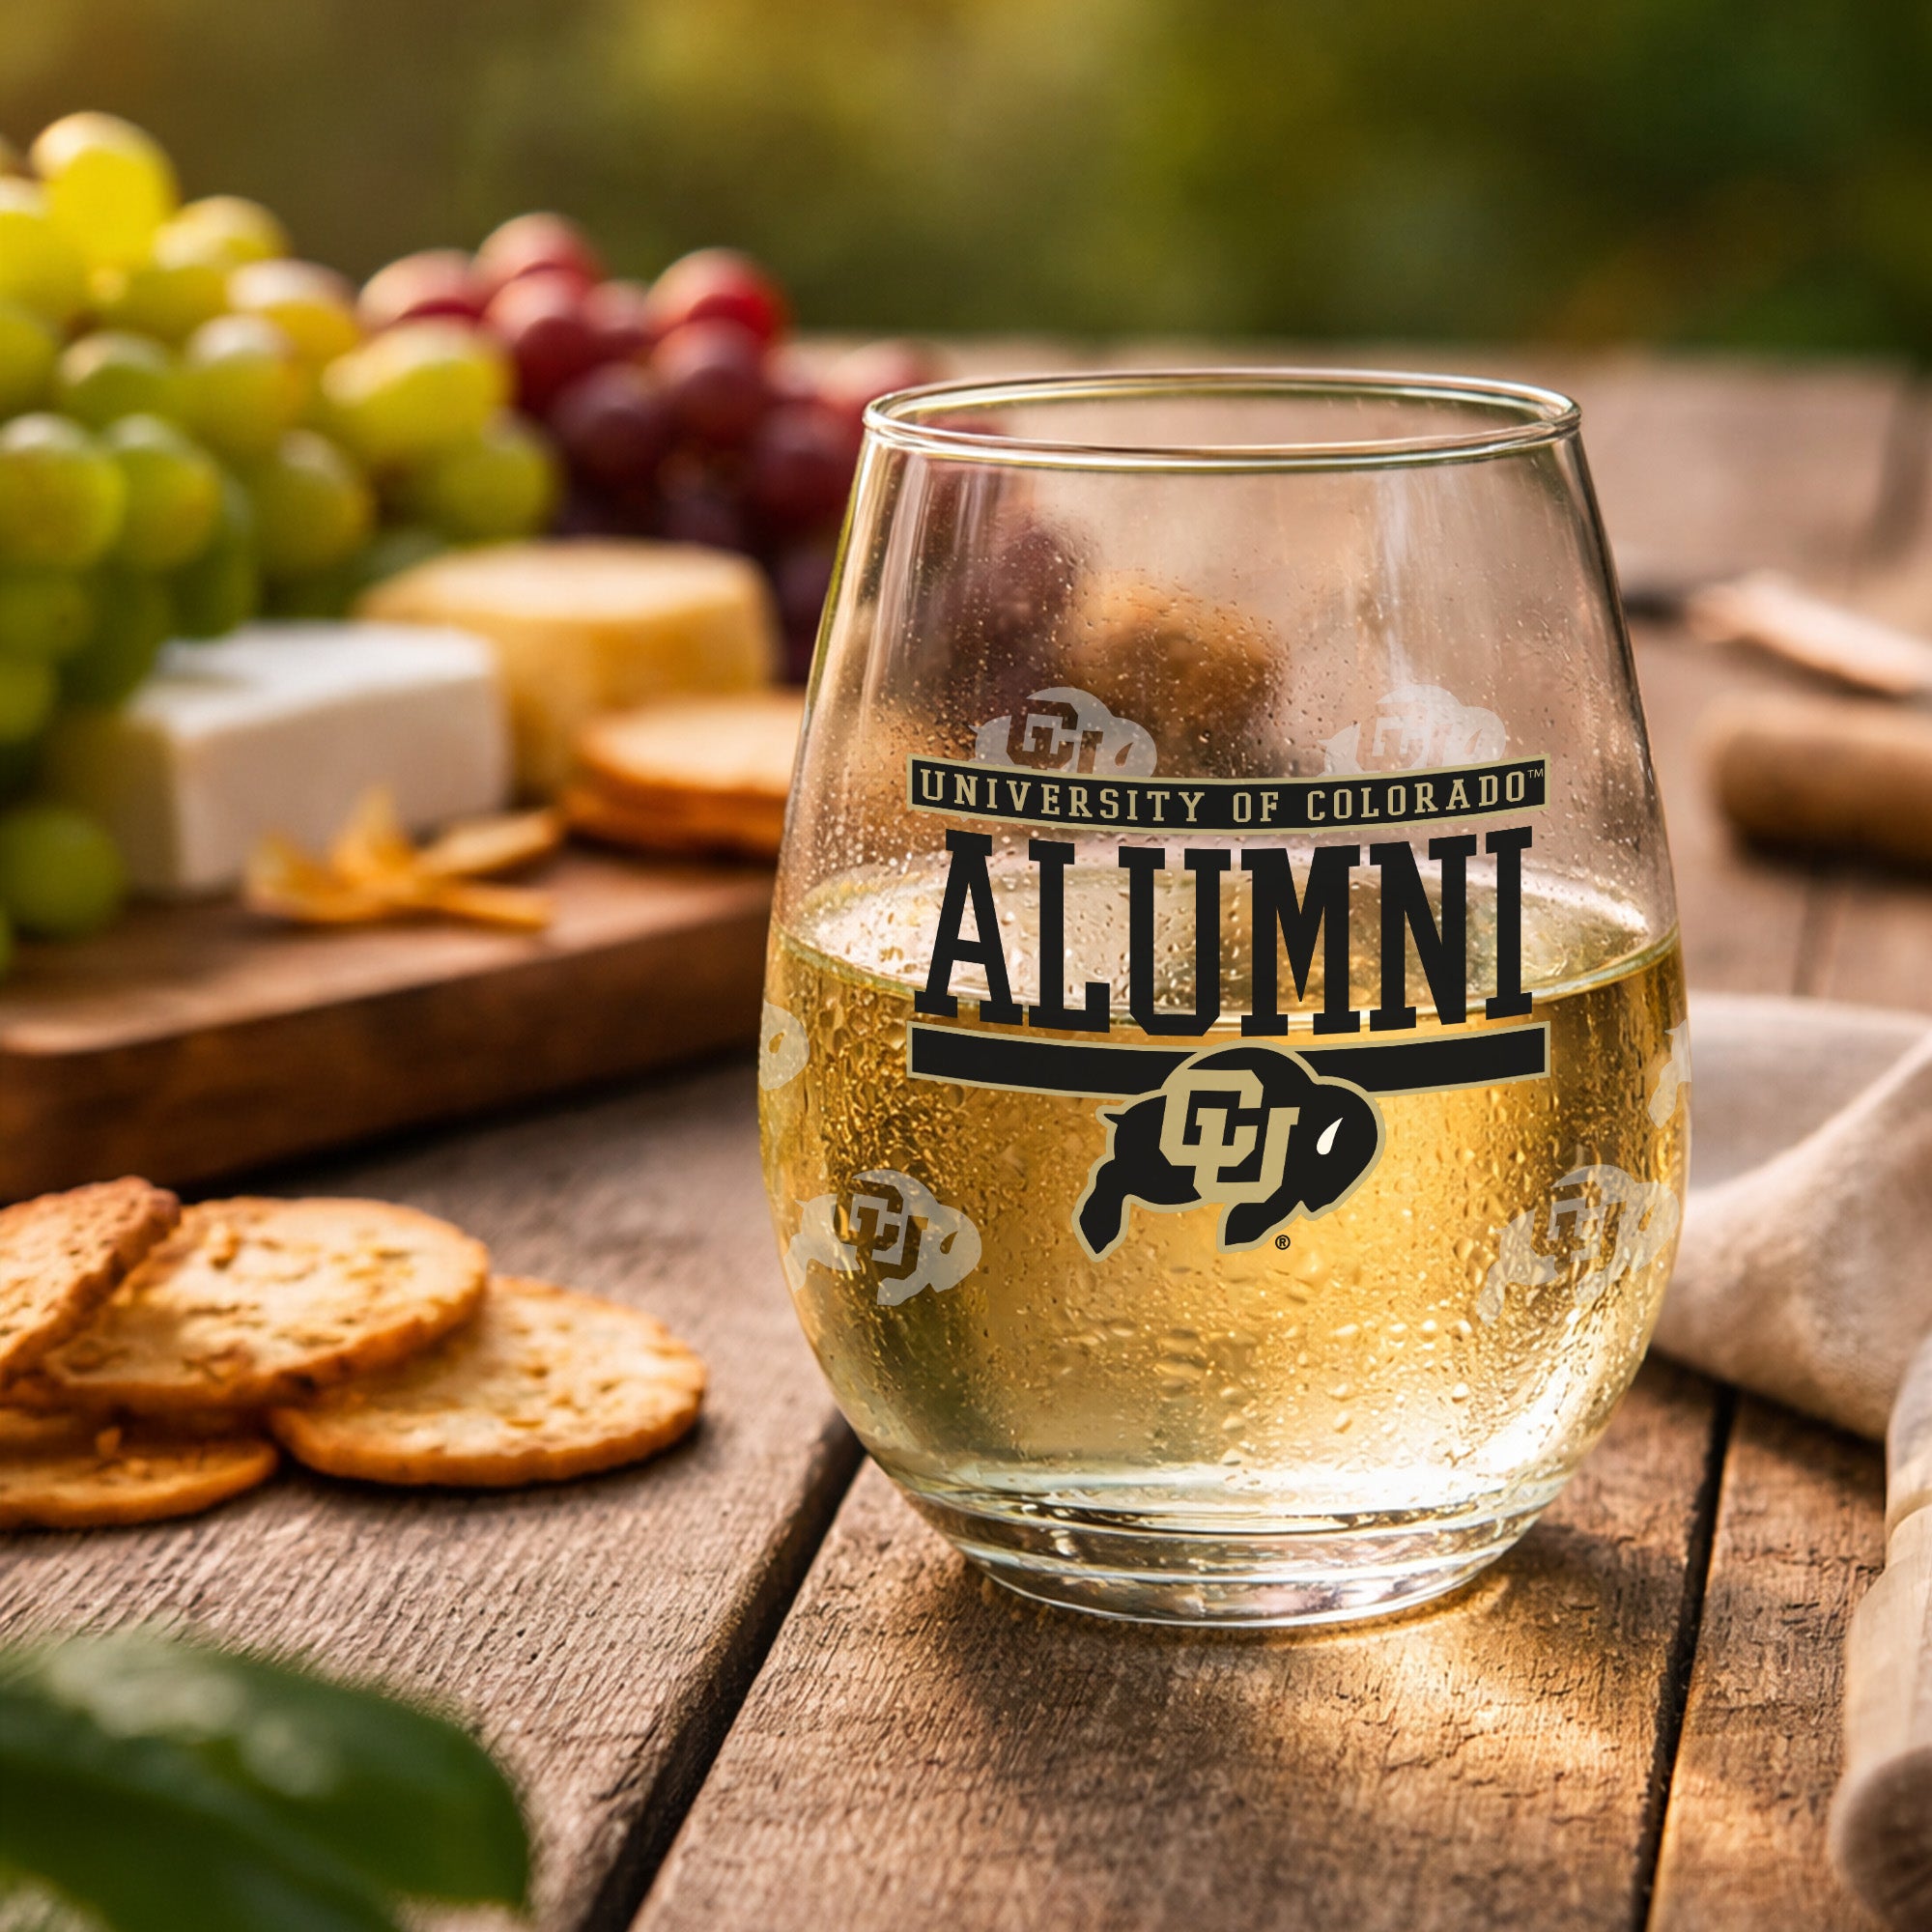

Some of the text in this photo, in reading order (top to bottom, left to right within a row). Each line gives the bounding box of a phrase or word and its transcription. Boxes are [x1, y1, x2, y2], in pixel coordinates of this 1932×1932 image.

[921, 769, 1205, 822] UNIVERSITY
[1233, 791, 1278, 824] OF
[914, 825, 1532, 1037] ALUMNI
[1159, 1069, 1300, 1204] CU
